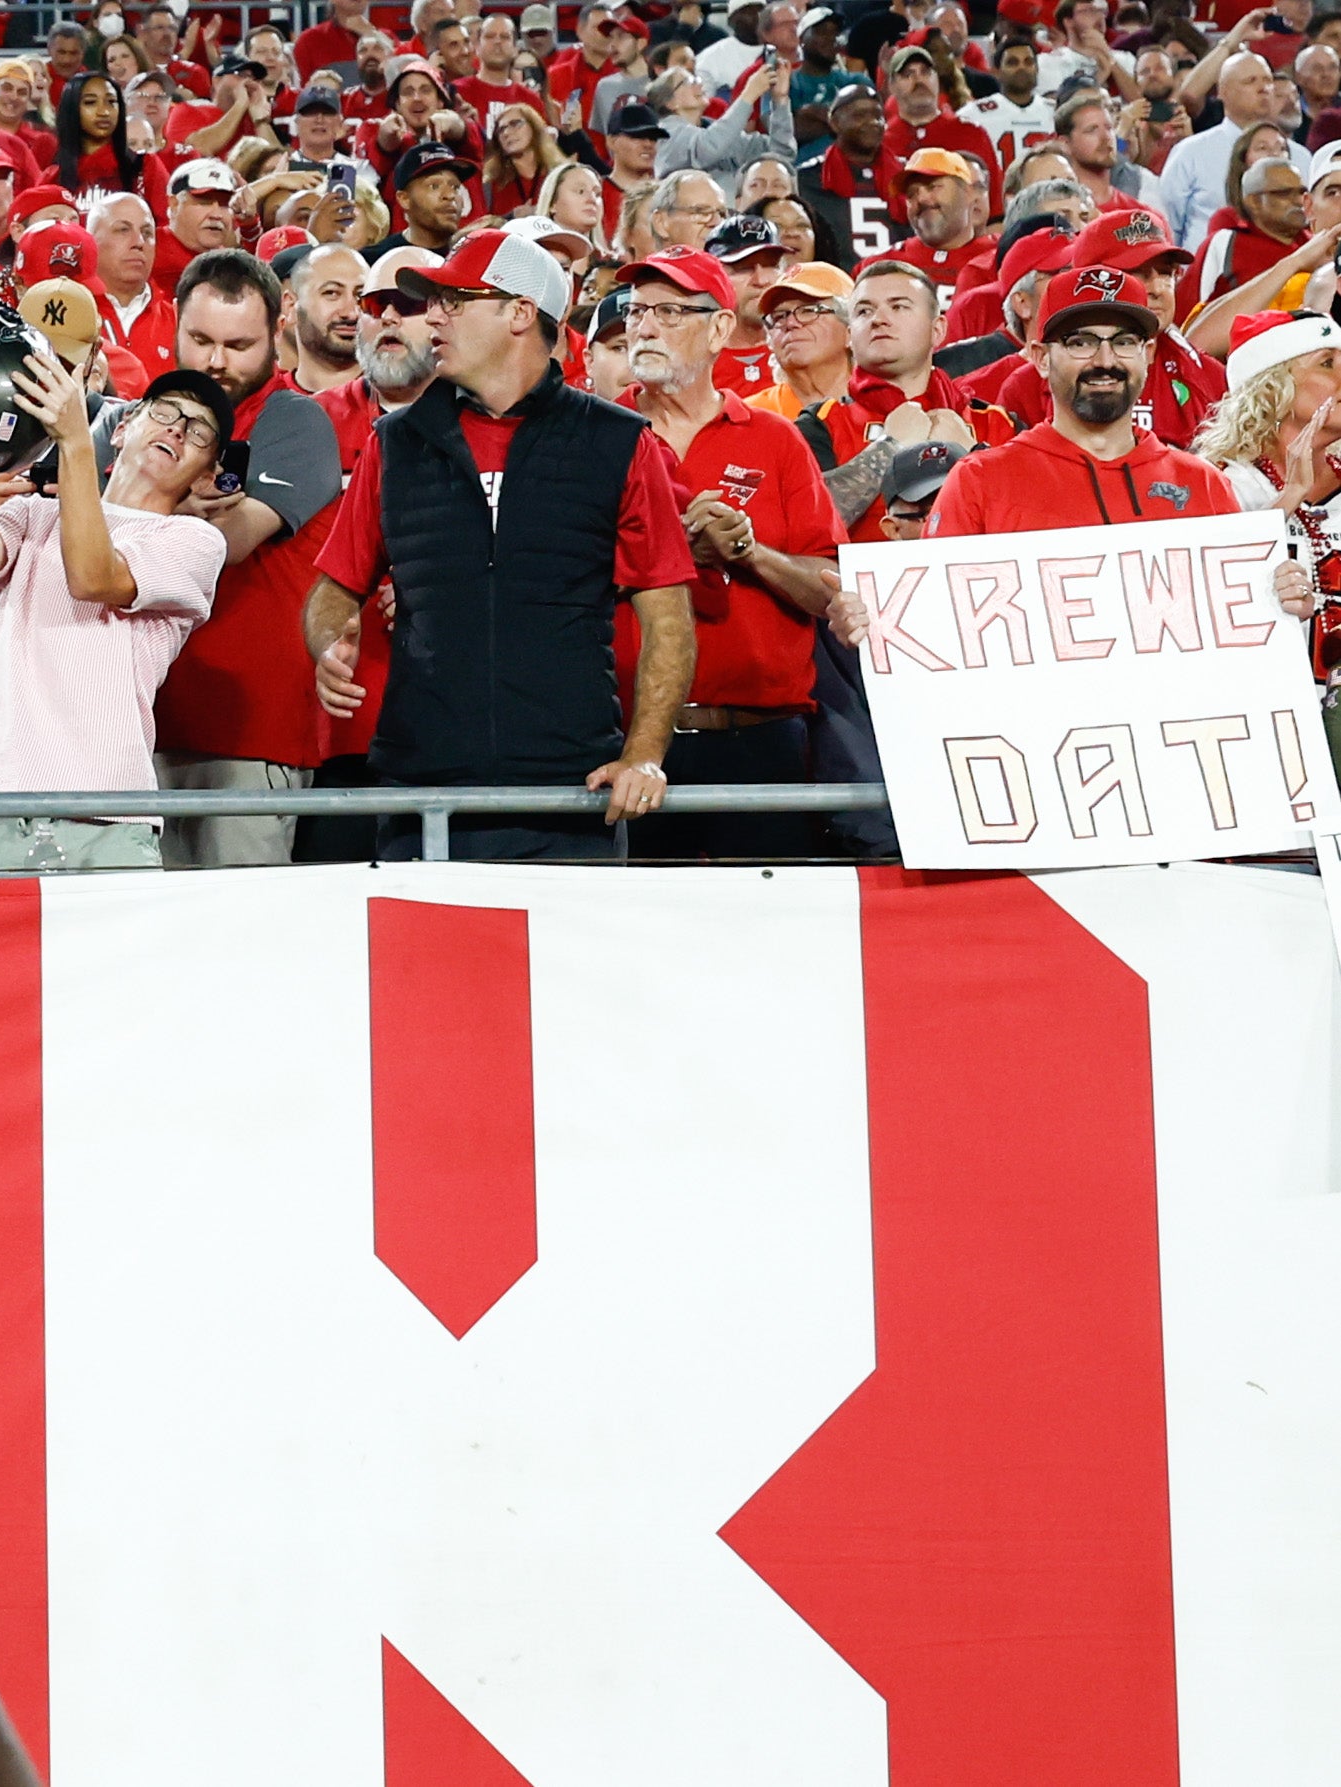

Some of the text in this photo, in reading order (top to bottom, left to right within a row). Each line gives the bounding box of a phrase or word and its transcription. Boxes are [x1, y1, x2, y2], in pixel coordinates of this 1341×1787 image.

[41, 298, 68, 326] NY
[856, 540, 1278, 675] KREWE
[942, 709, 1317, 845] DAT!
